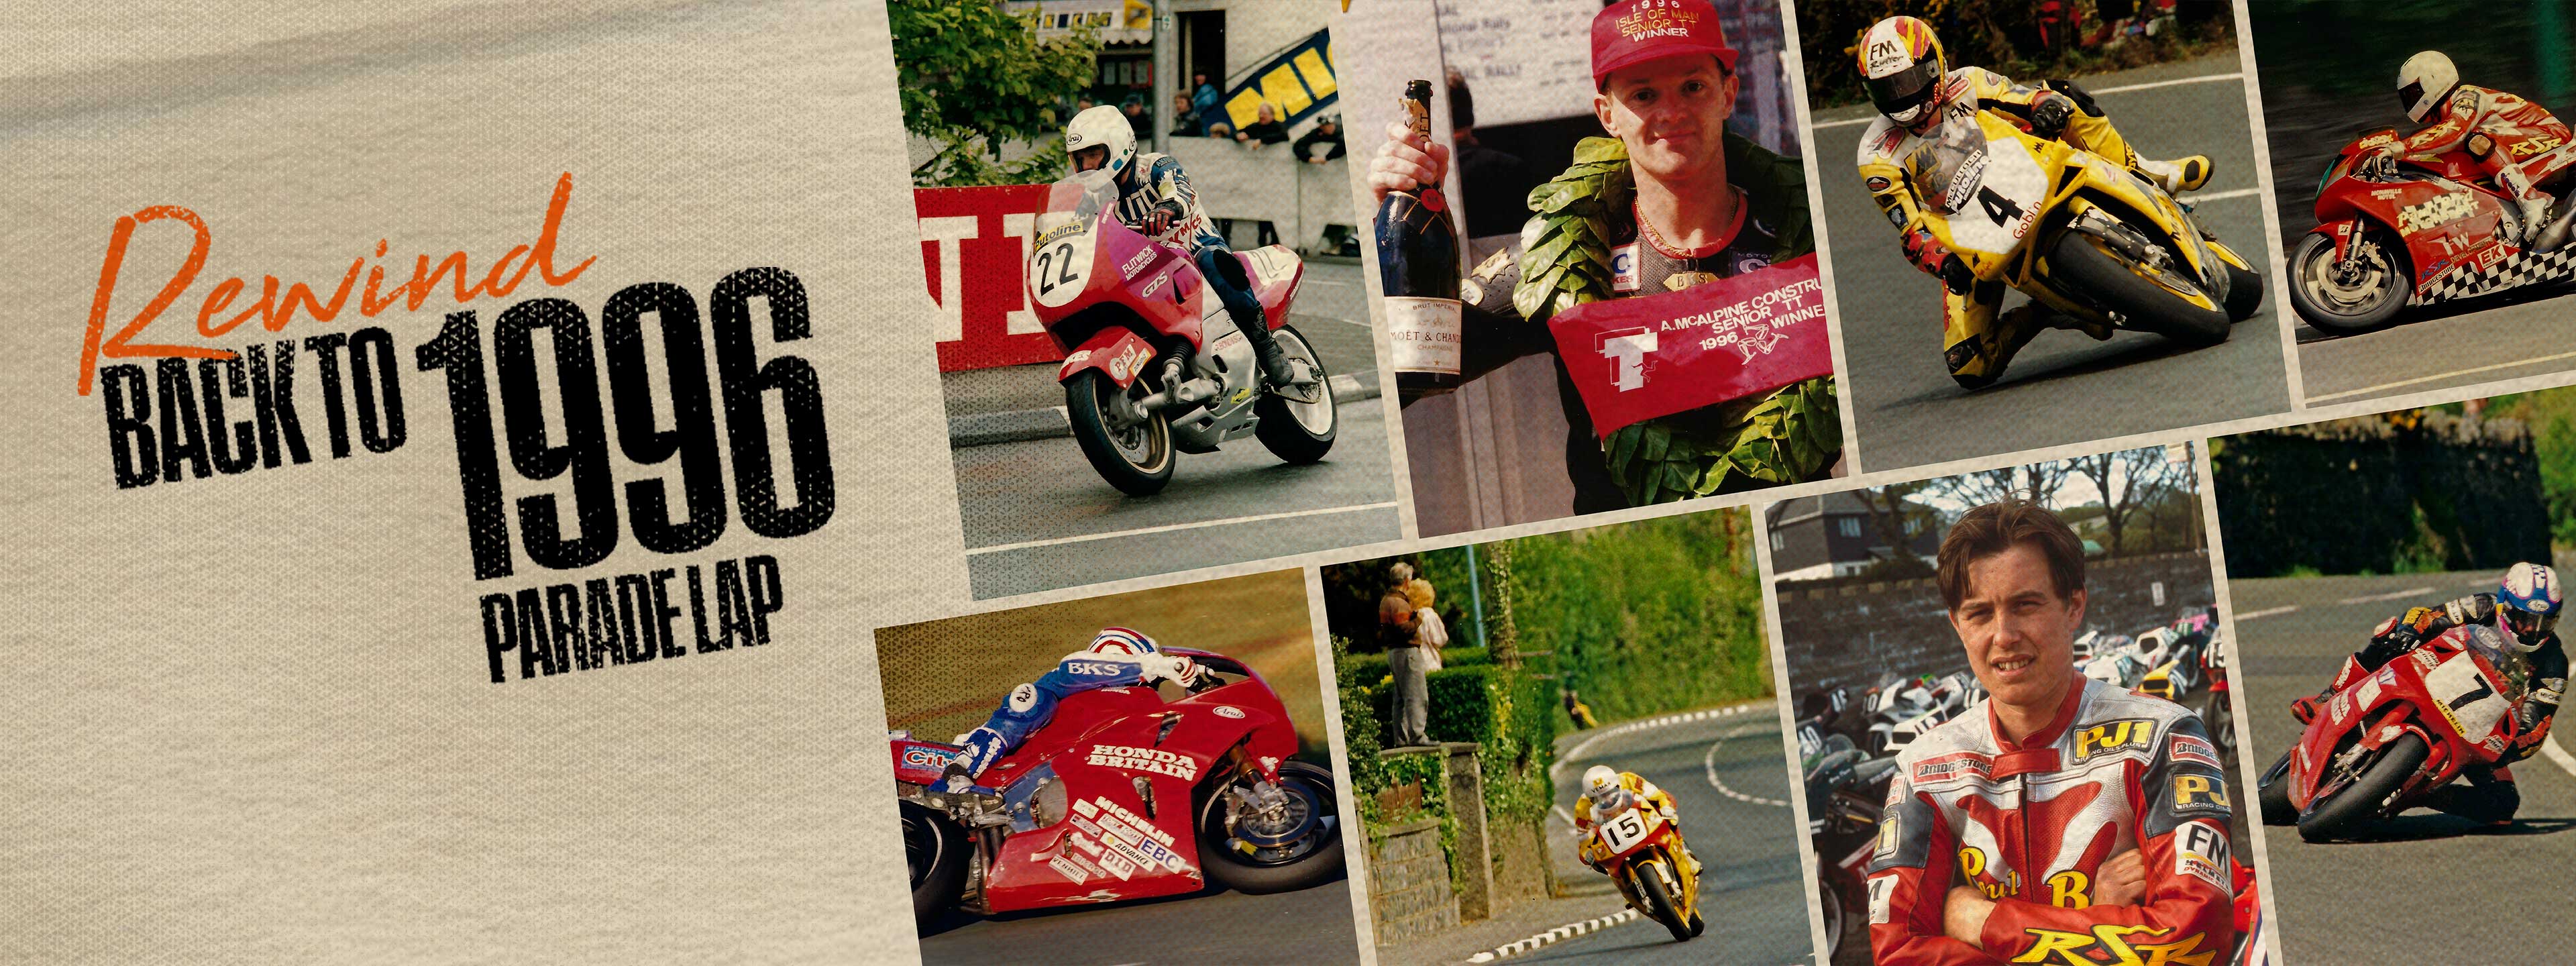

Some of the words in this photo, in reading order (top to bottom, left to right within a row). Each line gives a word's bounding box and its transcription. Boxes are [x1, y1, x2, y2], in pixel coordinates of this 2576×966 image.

[1615, 12, 1643, 30] ISLE
[1648, 8, 1666, 19] OF
[1671, 9, 1700, 22] MAN
[1621, 19, 1672, 37] SENIOR
[1678, 19, 1697, 29] TT
[1632, 28, 1689, 42] WINNER
[1870, 40, 1898, 60] FM
[1949, 102, 1973, 121] FM
[2510, 136, 2563, 156] RSR
[1977, 185, 2025, 228] 4
[1035, 223, 1081, 249] Putoline
[1122, 244, 1153, 274] FLITWICK
[1126, 252, 1157, 282] MOTORCYCLES
[2481, 246, 2504, 264] EK
[1037, 243, 1079, 297] 22
[2420, 264, 2455, 292] BRIDGESTONE
[1412, 303, 1431, 311] BRUT
[1713, 306, 1773, 334] SENIOR
[1782, 295, 1803, 311] TT
[1425, 331, 1432, 341] &
[1699, 331, 1739, 351] 1996
[1770, 304, 1826, 329] WINNE
[1067, 661, 1121, 677] BKS
[2449, 673, 2493, 712] 7
[1218, 707, 1244, 718] Arai
[2436, 699, 2465, 735] MICHELIN
[2076, 720, 2153, 759] PJ1
[1087, 754, 1198, 782] BRITAIN
[1091, 745, 1198, 770] HONDA
[2181, 802, 2215, 810] RACING
[1094, 796, 1175, 847] MICHELIN
[1607, 816, 1640, 847] 15
[1115, 843, 1149, 866] ADVANCE
[1140, 839, 1179, 870] EBC
[2186, 824, 2228, 876] FM
